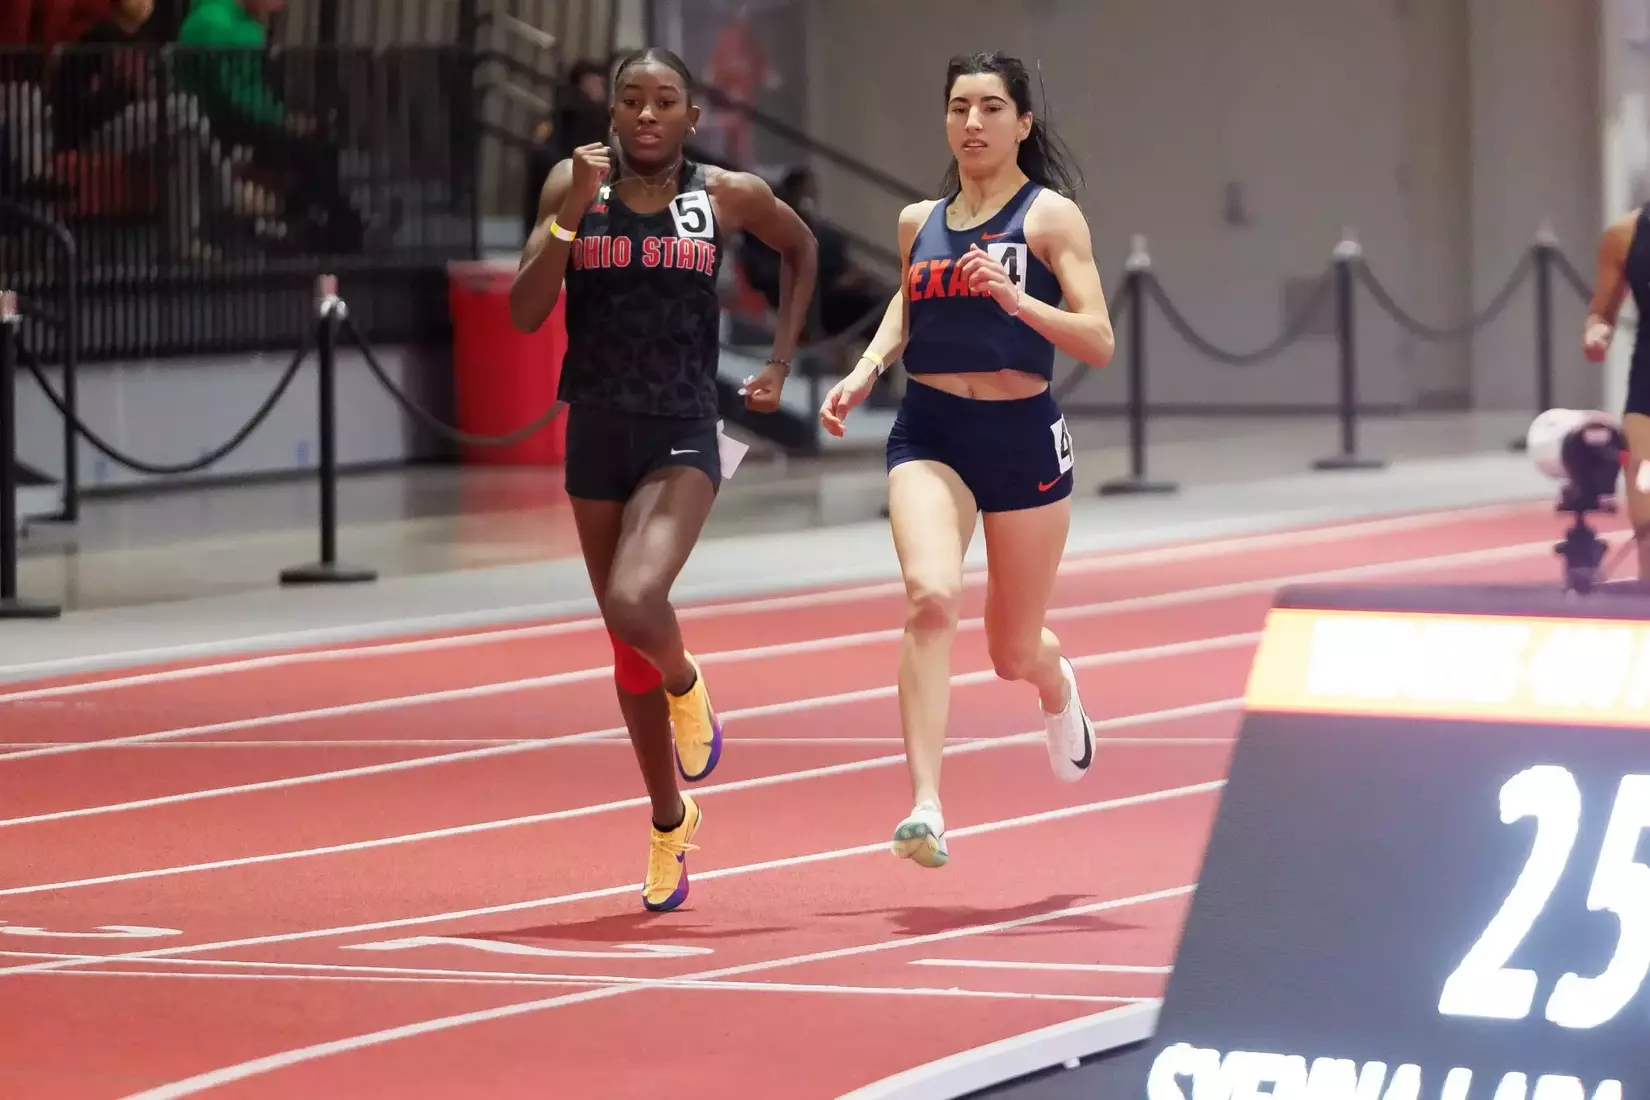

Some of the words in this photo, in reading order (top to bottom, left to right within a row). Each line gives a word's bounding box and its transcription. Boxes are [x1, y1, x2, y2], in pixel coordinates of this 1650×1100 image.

[676, 195, 707, 234] 5
[572, 236, 632, 271] OHIO
[642, 236, 716, 276] STATE
[1000, 246, 1021, 285] 4
[1060, 420, 1072, 462] 4
